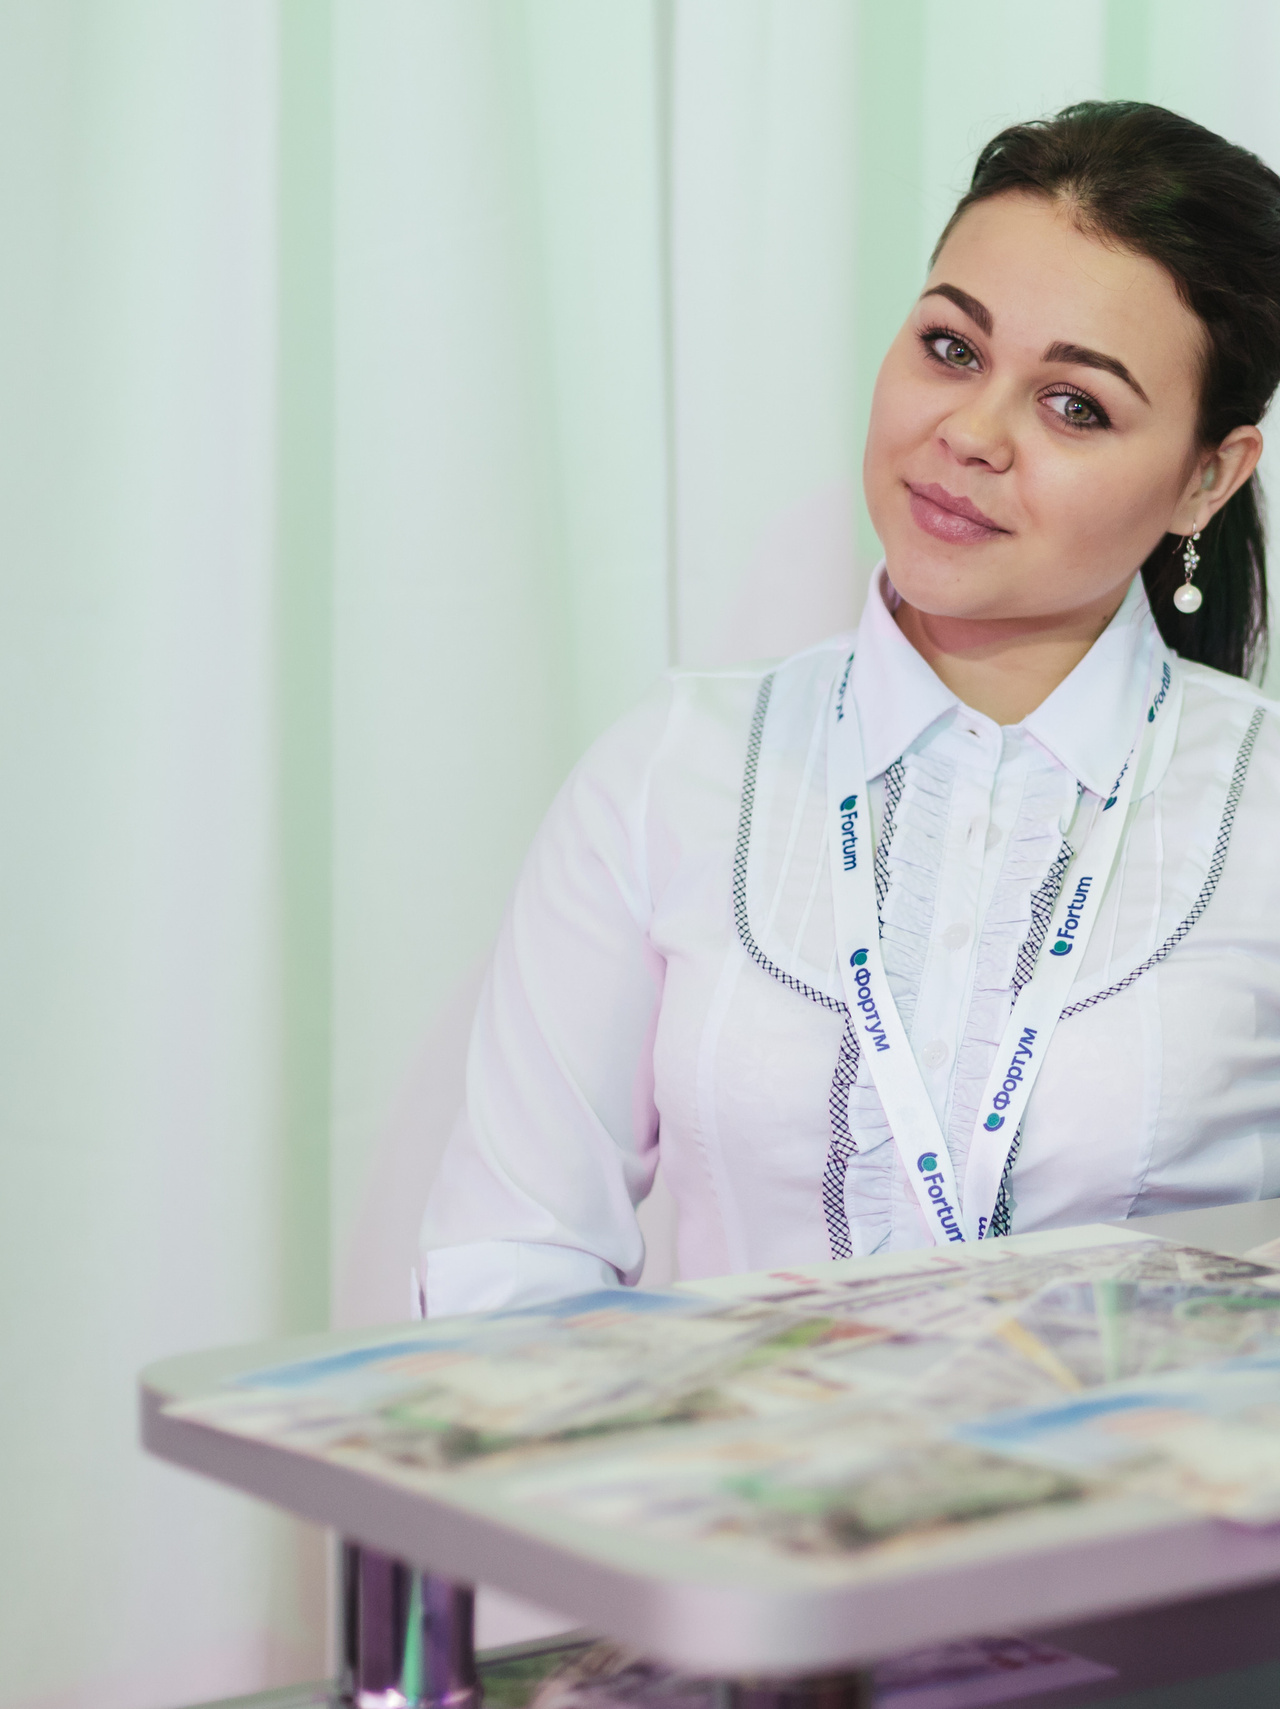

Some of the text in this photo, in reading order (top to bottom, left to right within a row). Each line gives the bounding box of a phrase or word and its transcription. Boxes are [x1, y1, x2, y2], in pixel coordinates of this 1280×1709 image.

[1153, 661, 1171, 711] Fortum
[840, 811, 858, 871] Fortum
[1057, 876, 1093, 940] Fortum
[854, 967, 890, 1052] Фортум
[992, 1027, 1038, 1111] Фортум
